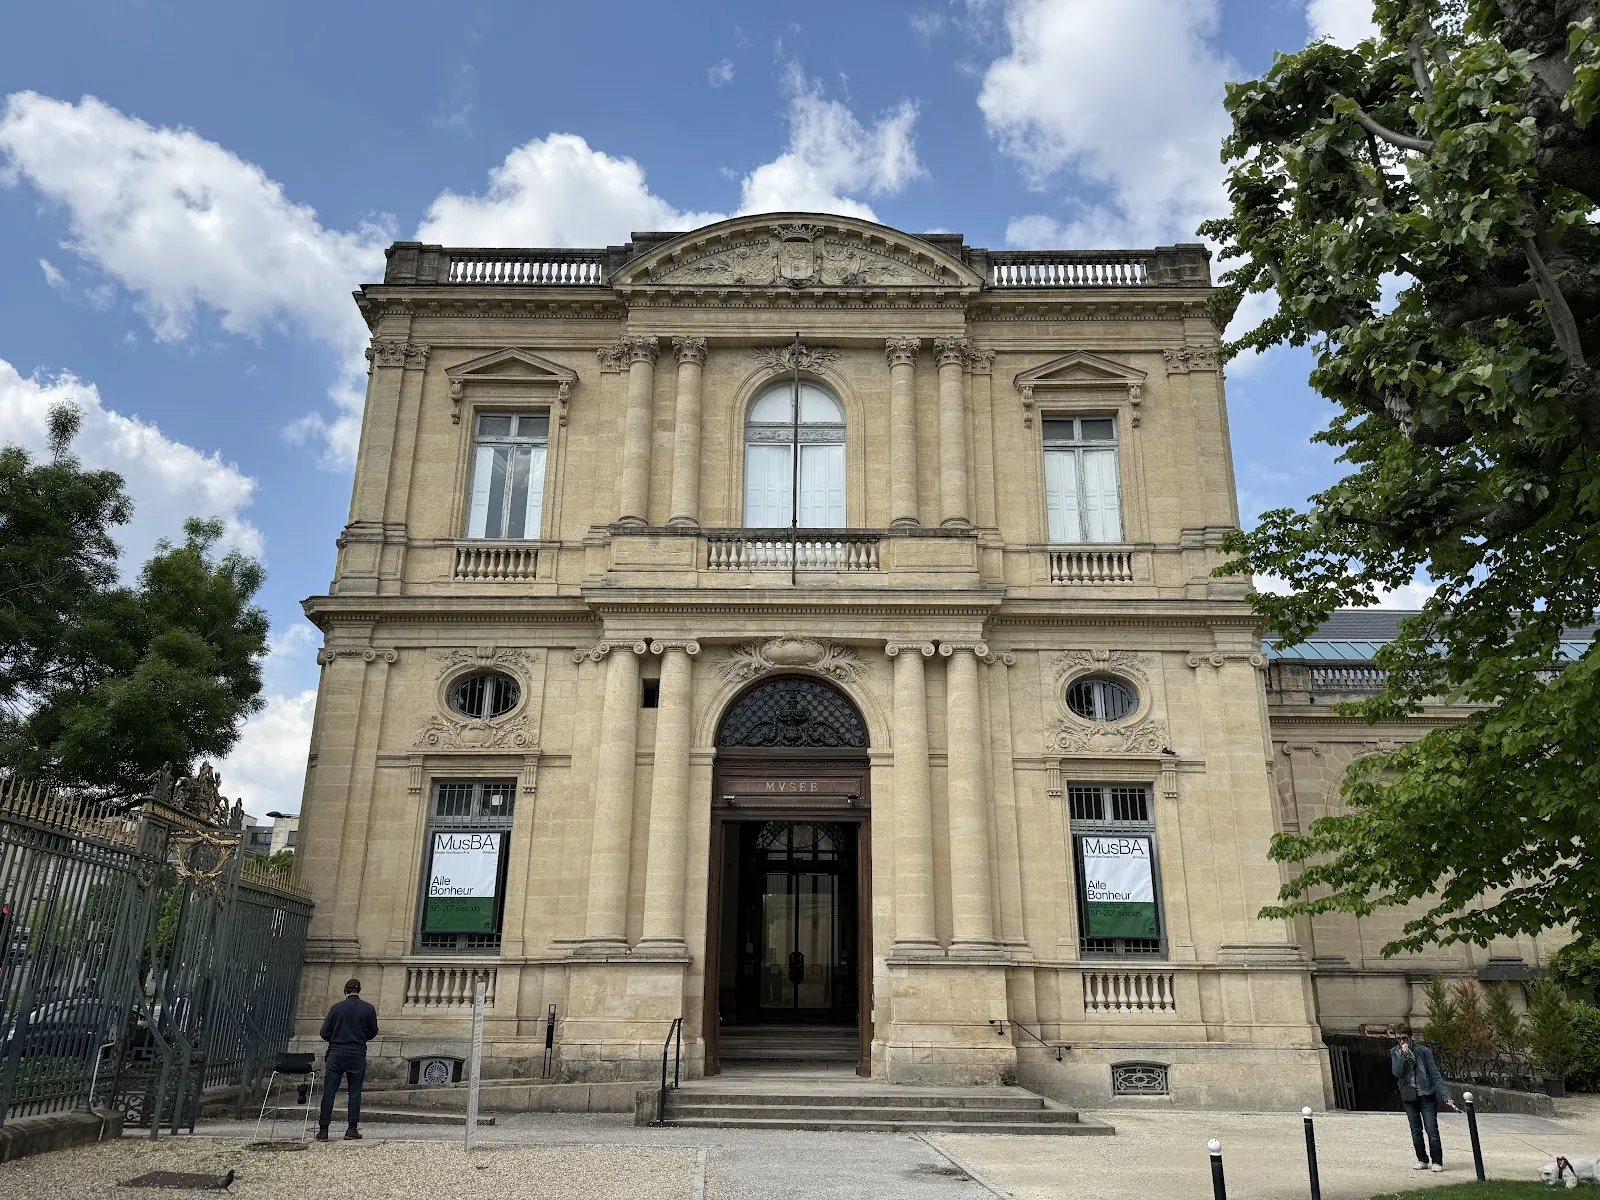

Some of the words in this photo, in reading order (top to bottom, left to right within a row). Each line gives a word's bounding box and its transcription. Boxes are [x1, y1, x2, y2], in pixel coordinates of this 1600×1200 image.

[765, 782, 818, 792] MVSEE
[437, 834, 495, 850] MusBA
[1085, 838, 1144, 855] MusBA
[431, 876, 451, 886] Aile
[1087, 880, 1107, 890] Aile
[430, 885, 474, 896] Bonheur
[1087, 890, 1132, 900] Bonheur
